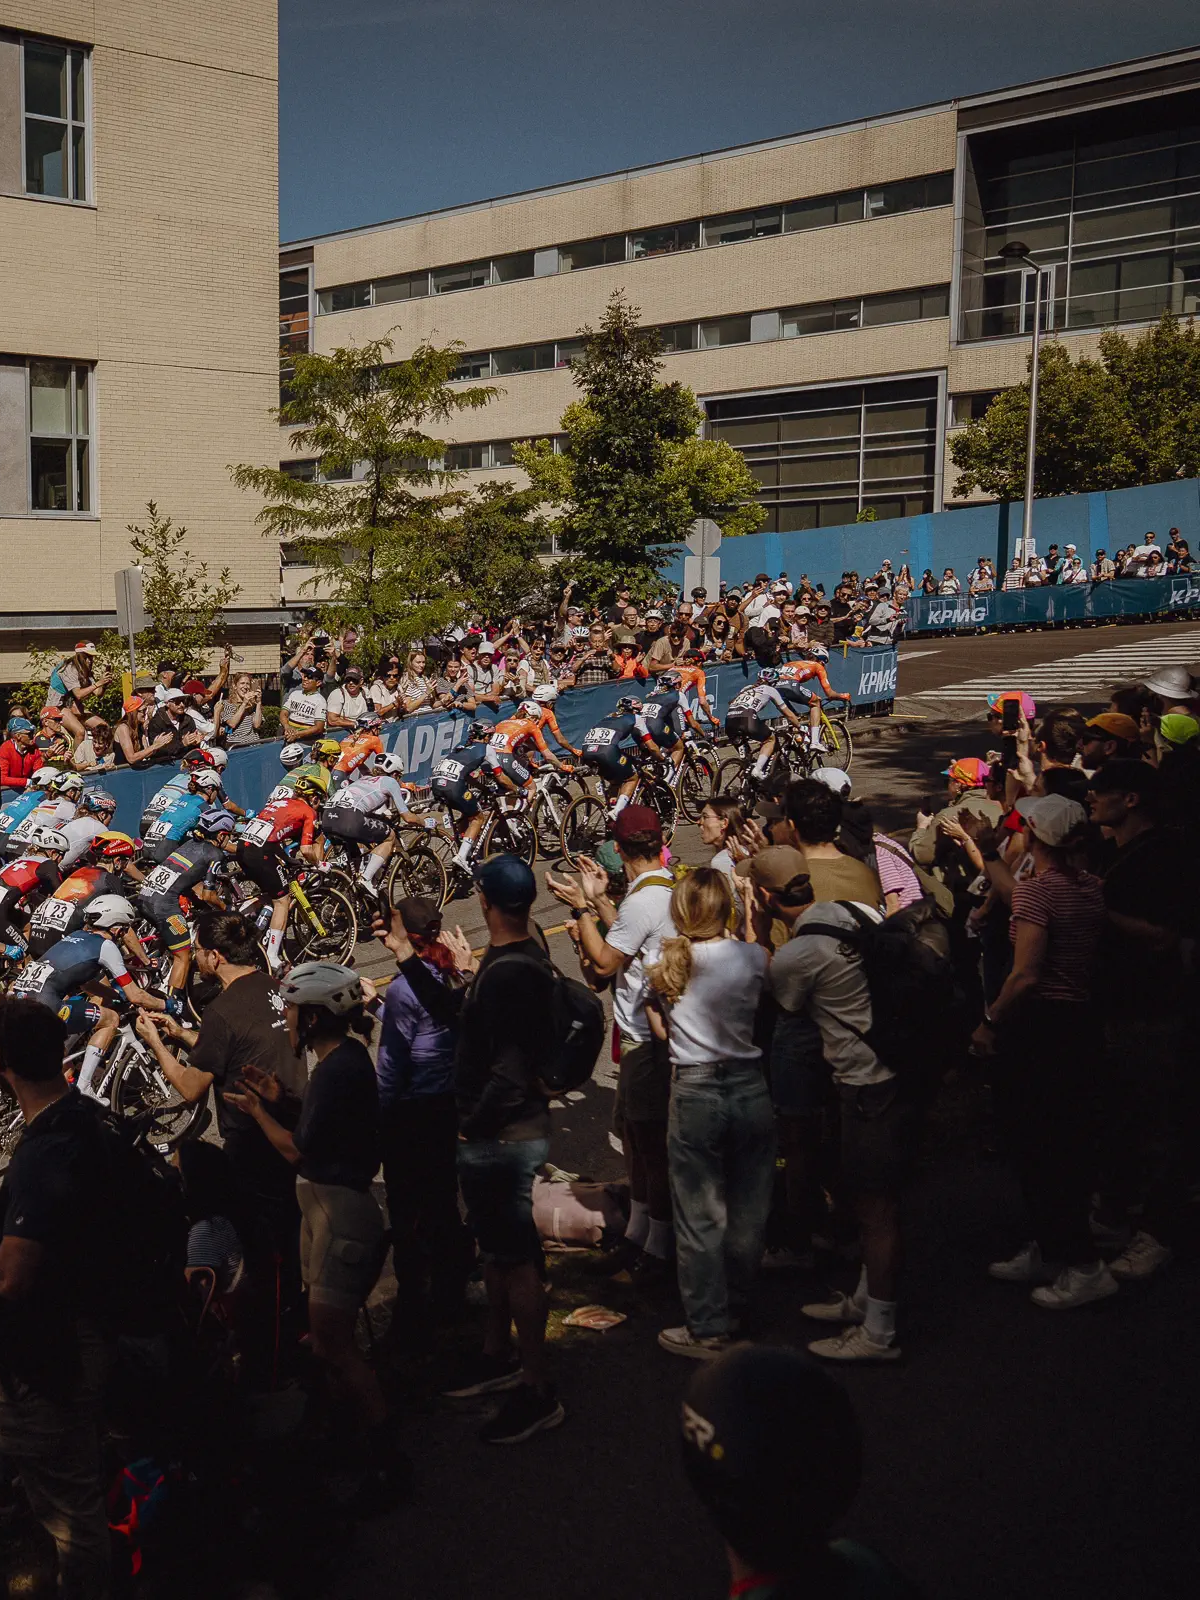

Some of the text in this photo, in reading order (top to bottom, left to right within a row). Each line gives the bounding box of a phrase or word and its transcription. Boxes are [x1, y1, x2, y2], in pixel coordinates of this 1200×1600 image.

[1169, 588, 1200, 604] KP
[927, 607, 987, 625] KPMG
[155, 823, 165, 833] 16
[43, 836, 54, 845] EF
[155, 871, 170, 885] 88
[49, 904, 67, 919] 23
